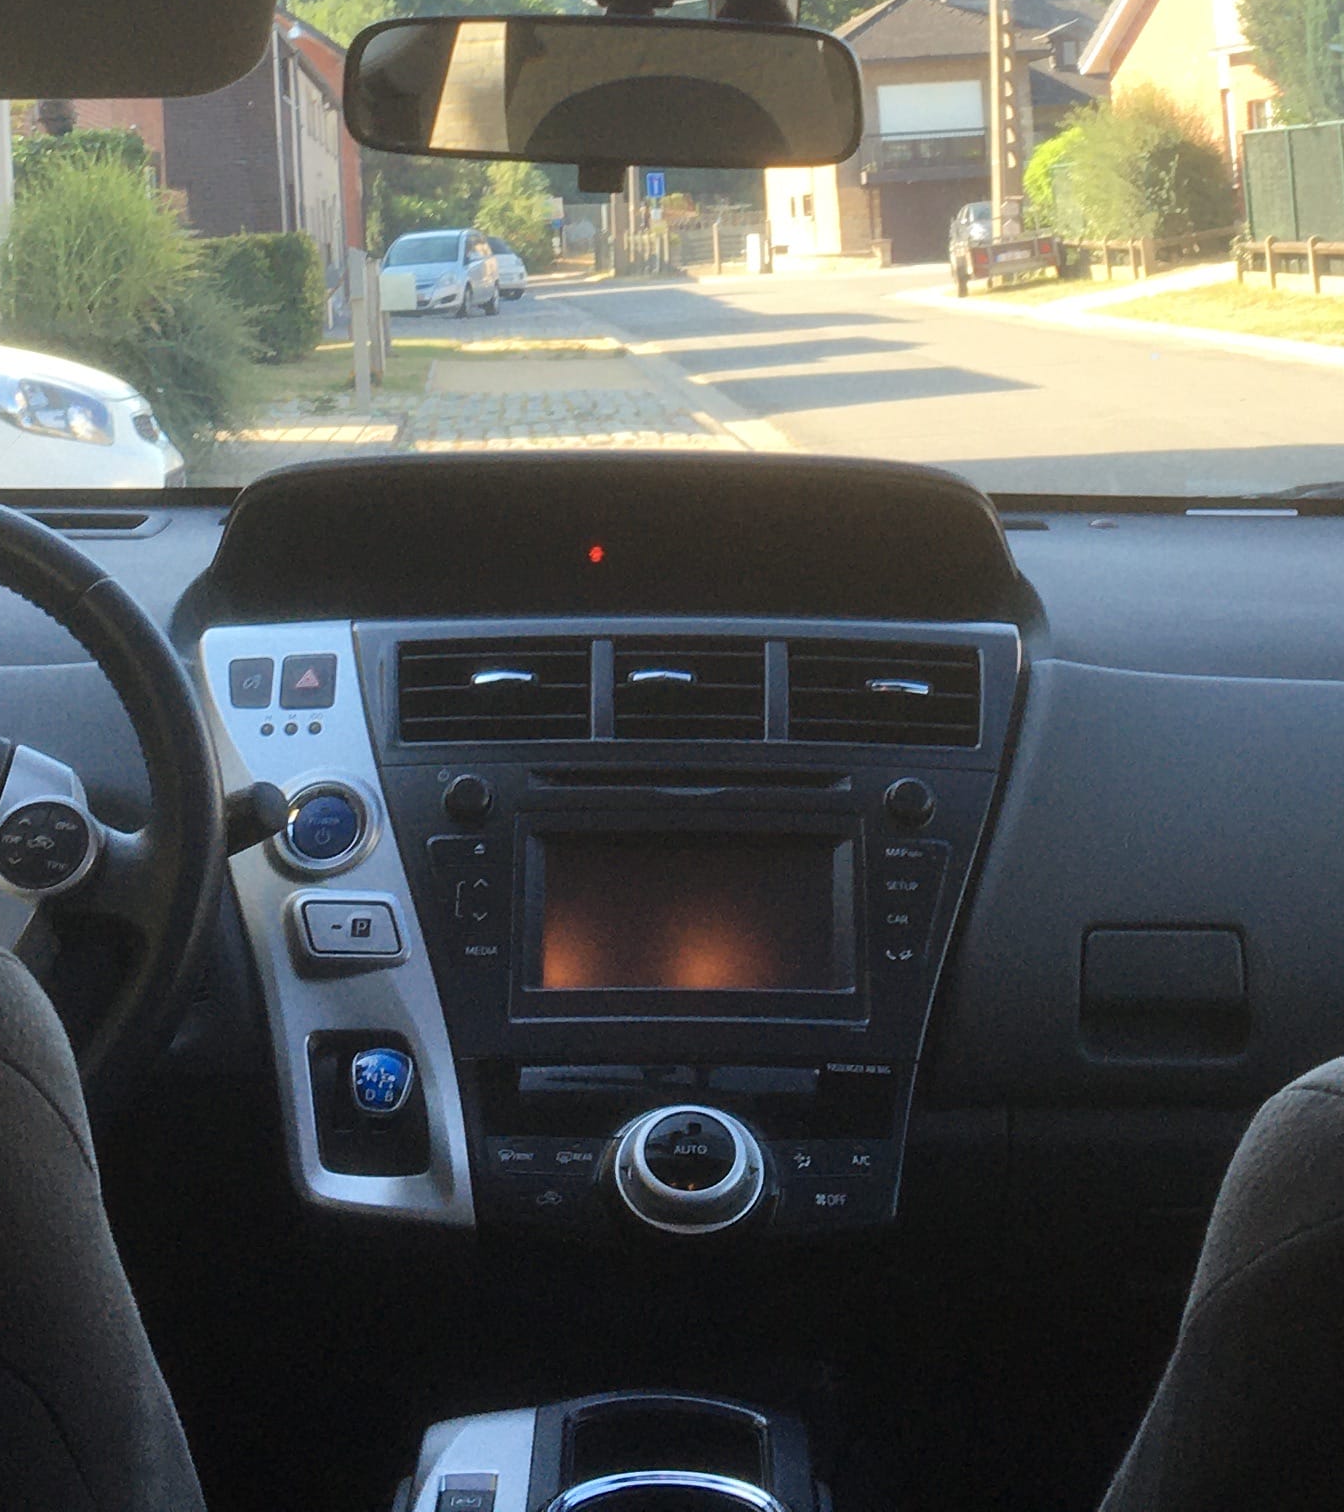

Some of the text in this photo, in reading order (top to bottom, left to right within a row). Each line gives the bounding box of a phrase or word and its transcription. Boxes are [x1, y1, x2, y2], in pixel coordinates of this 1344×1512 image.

[465, 945, 499, 956] MEDIA
[673, 1144, 708, 1155] AUTO
[851, 1154, 871, 1166] A/C
[826, 1194, 847, 1206] OFF
